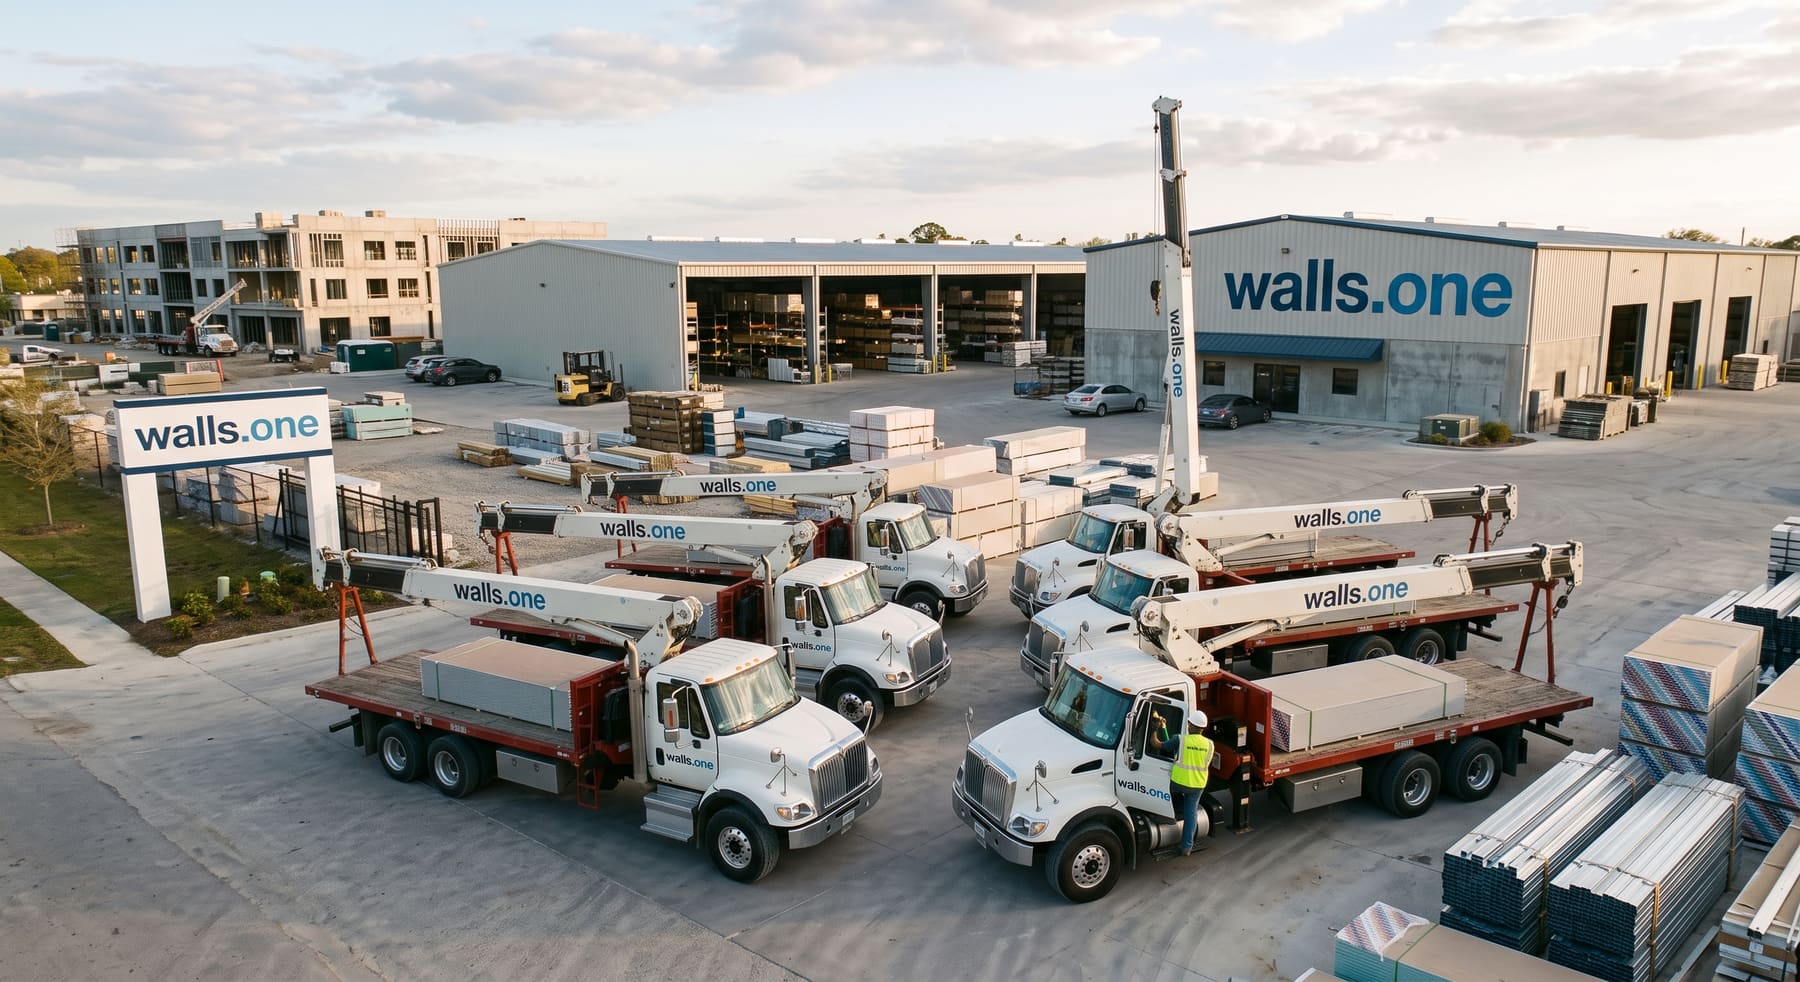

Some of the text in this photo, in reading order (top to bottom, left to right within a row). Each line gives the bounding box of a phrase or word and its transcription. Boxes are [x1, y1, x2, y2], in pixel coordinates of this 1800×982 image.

[1226, 258, 1512, 317] walls.one
[1170, 309, 1184, 397] walls.one
[135, 415, 318, 450] walls.one
[700, 478, 776, 493] walls.one
[1294, 509, 1381, 528] walls.one
[600, 520, 685, 540] walls.one
[453, 583, 546, 610] walls.one
[1304, 582, 1408, 609] walls.one
[791, 641, 831, 651] walls.one
[666, 754, 713, 769] walls.one
[1118, 779, 1171, 801] walls.one
